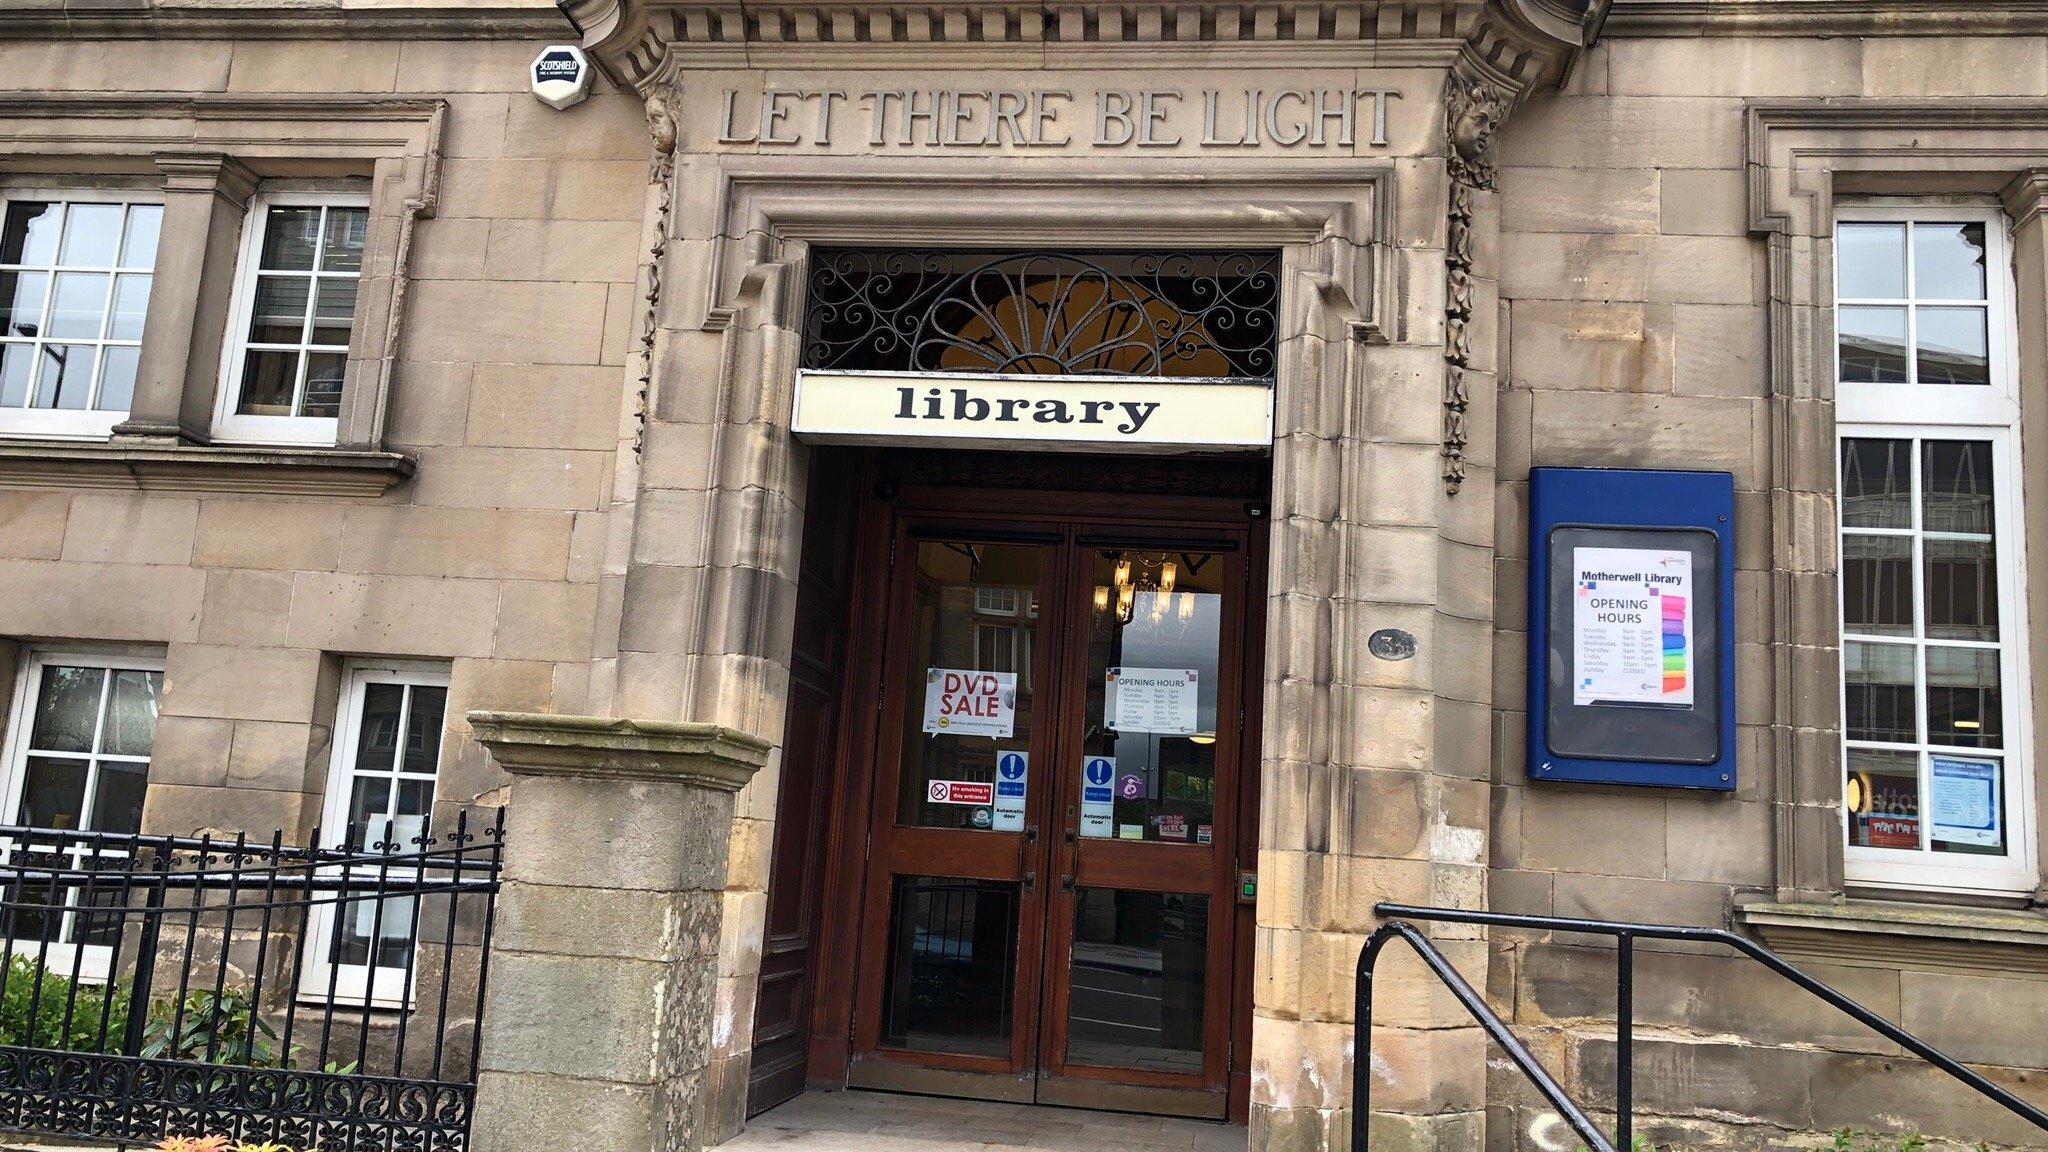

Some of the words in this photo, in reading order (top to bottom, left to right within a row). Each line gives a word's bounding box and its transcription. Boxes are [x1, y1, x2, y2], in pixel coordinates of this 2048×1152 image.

[540, 60, 577, 70] SCOTSHIELD
[718, 89, 847, 145] LET
[861, 90, 1073, 146] THERE
[1092, 89, 1182, 147] BE
[1200, 89, 1403, 147] LIGHT
[895, 387, 1160, 433] library
[1581, 571, 1641, 582] Motherwell
[1644, 573, 1683, 586] Library
[1590, 598, 1648, 610] OPENING
[1597, 613, 1642, 623] HOURS
[944, 673, 999, 696] DVD
[1118, 678, 1154, 686] OPENING
[940, 693, 999, 718] SALE
